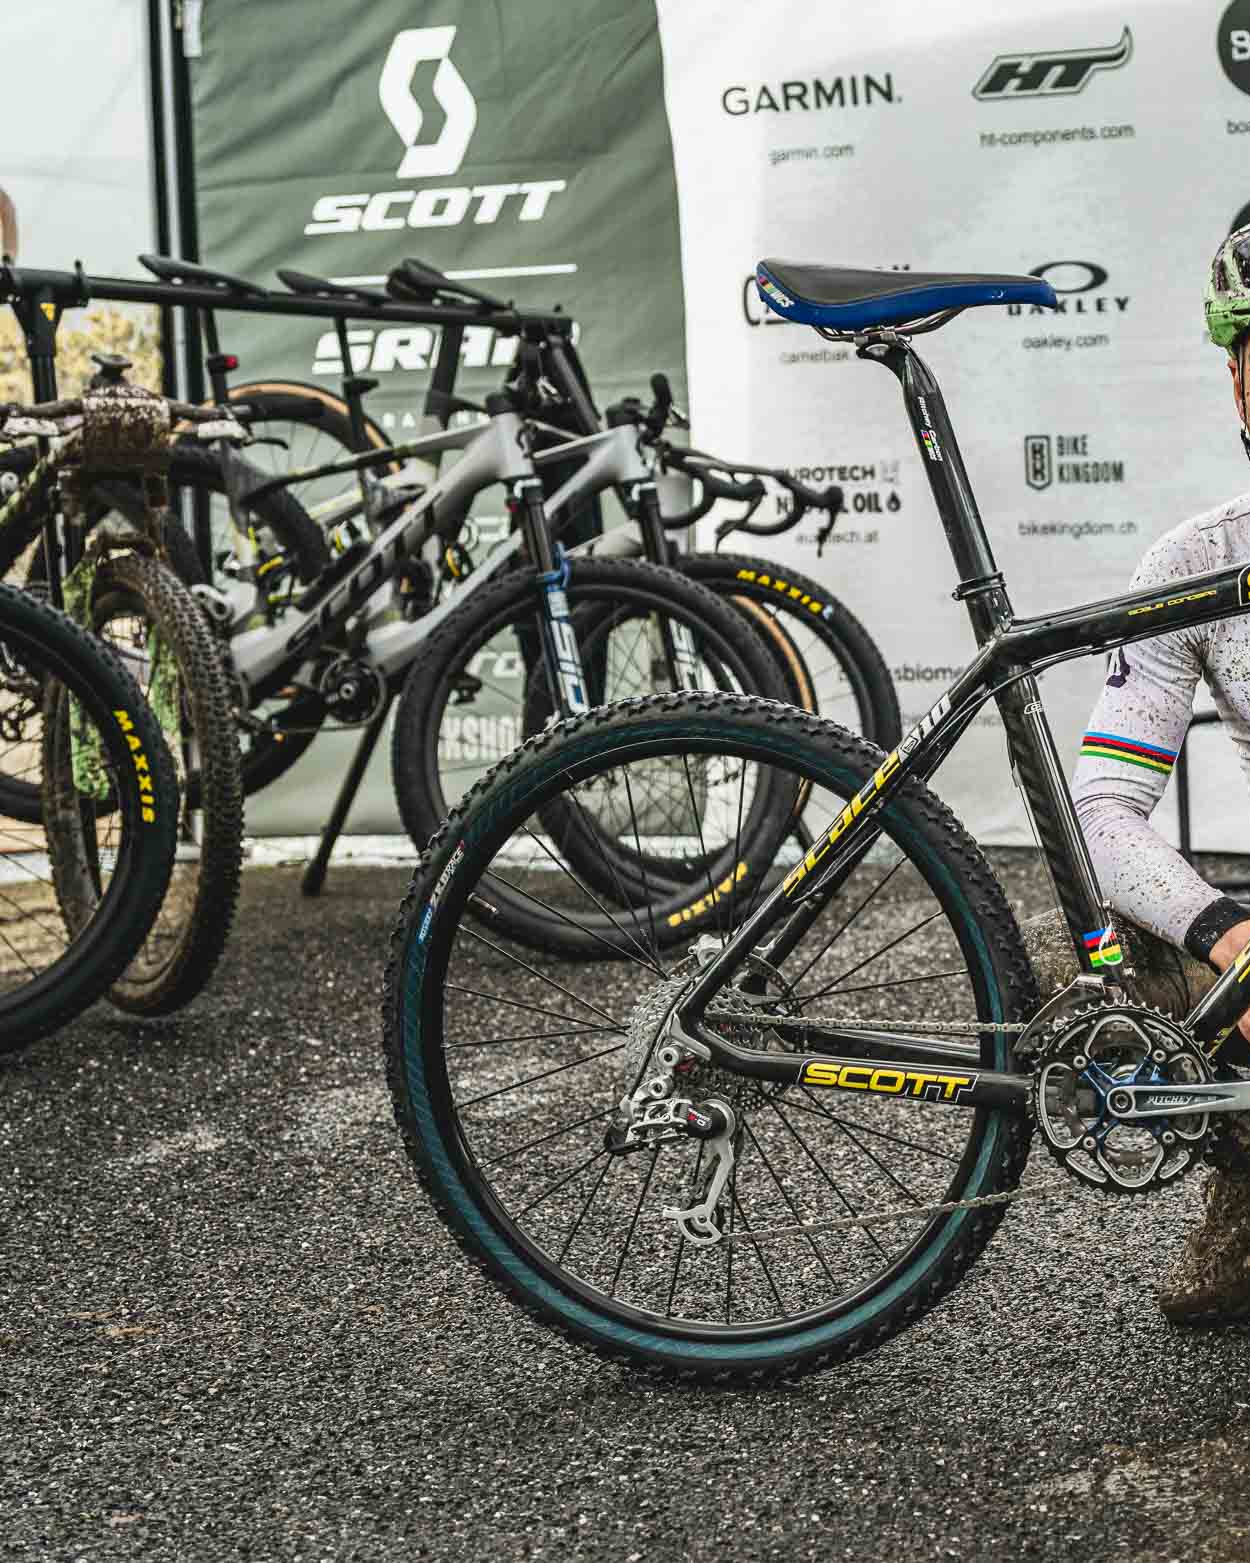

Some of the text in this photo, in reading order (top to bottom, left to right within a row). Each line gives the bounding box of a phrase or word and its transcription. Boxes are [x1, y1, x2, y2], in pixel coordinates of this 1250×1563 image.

[979, 122, 1135, 147] ht-components.com
[769, 143, 854, 164] garmin.com
[304, 179, 567, 236] SCOTT
[1007, 296, 1130, 317] OAKLEY
[1022, 333, 1109, 351] oakley.com
[1056, 433, 1089, 456] BIKE
[1056, 459, 1125, 484] KINGDOM
[1018, 520, 1137, 539] bikekingdom.ch
[736, 568, 824, 616] MAXXIS
[112, 709, 156, 823] MAXXIS
[804, 1063, 973, 1099] SCOTT
